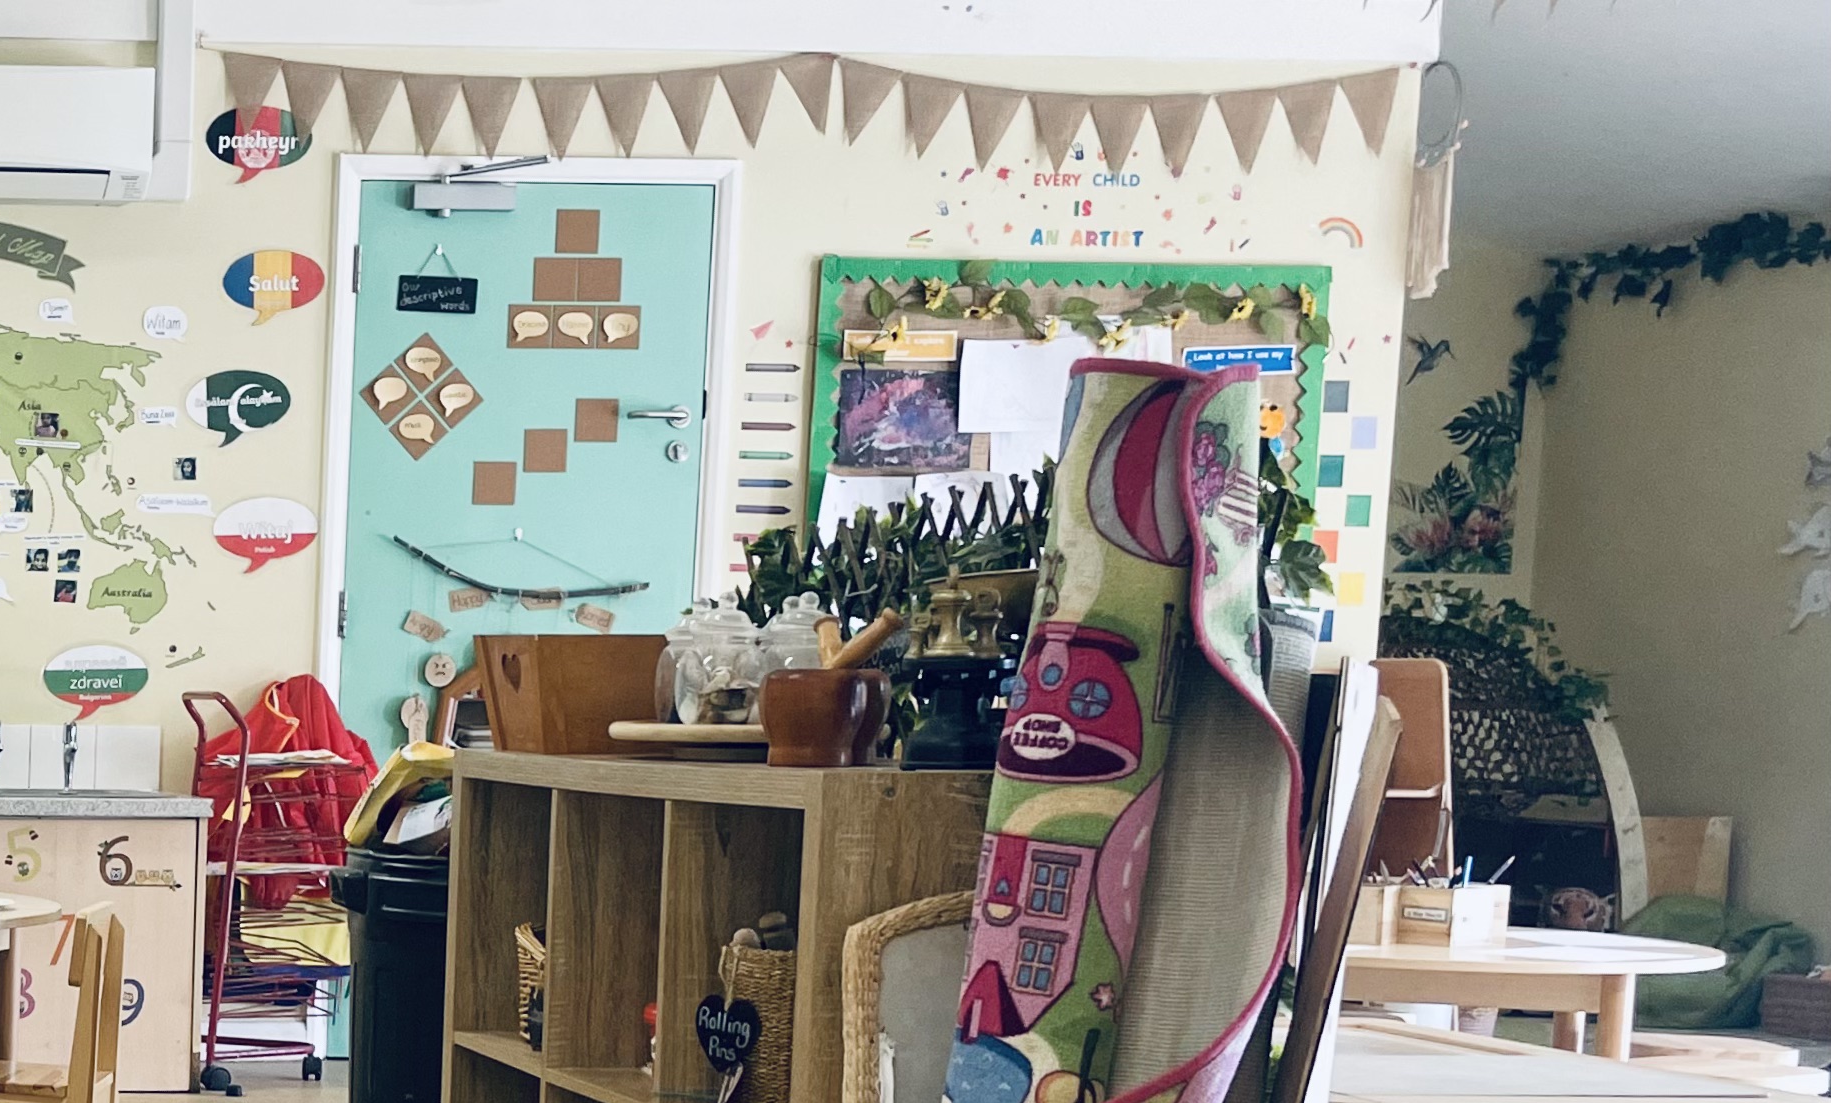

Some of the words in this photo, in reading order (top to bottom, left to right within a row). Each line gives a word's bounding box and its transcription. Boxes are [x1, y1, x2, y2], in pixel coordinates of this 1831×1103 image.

[1033, 173, 1081, 187] EVERY
[1092, 173, 1141, 187] CHILD
[1074, 200, 1092, 216] IS
[1030, 229, 1059, 246] AN
[1070, 230, 1144, 247] ARTIST
[7, 237, 57, 265] Map
[248, 274, 300, 292] Salut
[400, 286, 463, 306] descriptive
[440, 300, 471, 311] words
[146, 313, 182, 330] Witam
[1193, 352, 1214, 361] Look
[1215, 352, 1225, 360] at
[18, 400, 42, 411] Asia
[238, 520, 294, 544] Witaj
[100, 586, 153, 599] Australia
[1023, 719, 1062, 734] SHOP
[1013, 732, 1070, 750] COFFEE
[7, 826, 42, 883] 5
[99, 836, 133, 886] 6
[699, 1006, 750, 1049] Rolling
[709, 1035, 737, 1061] Pins
